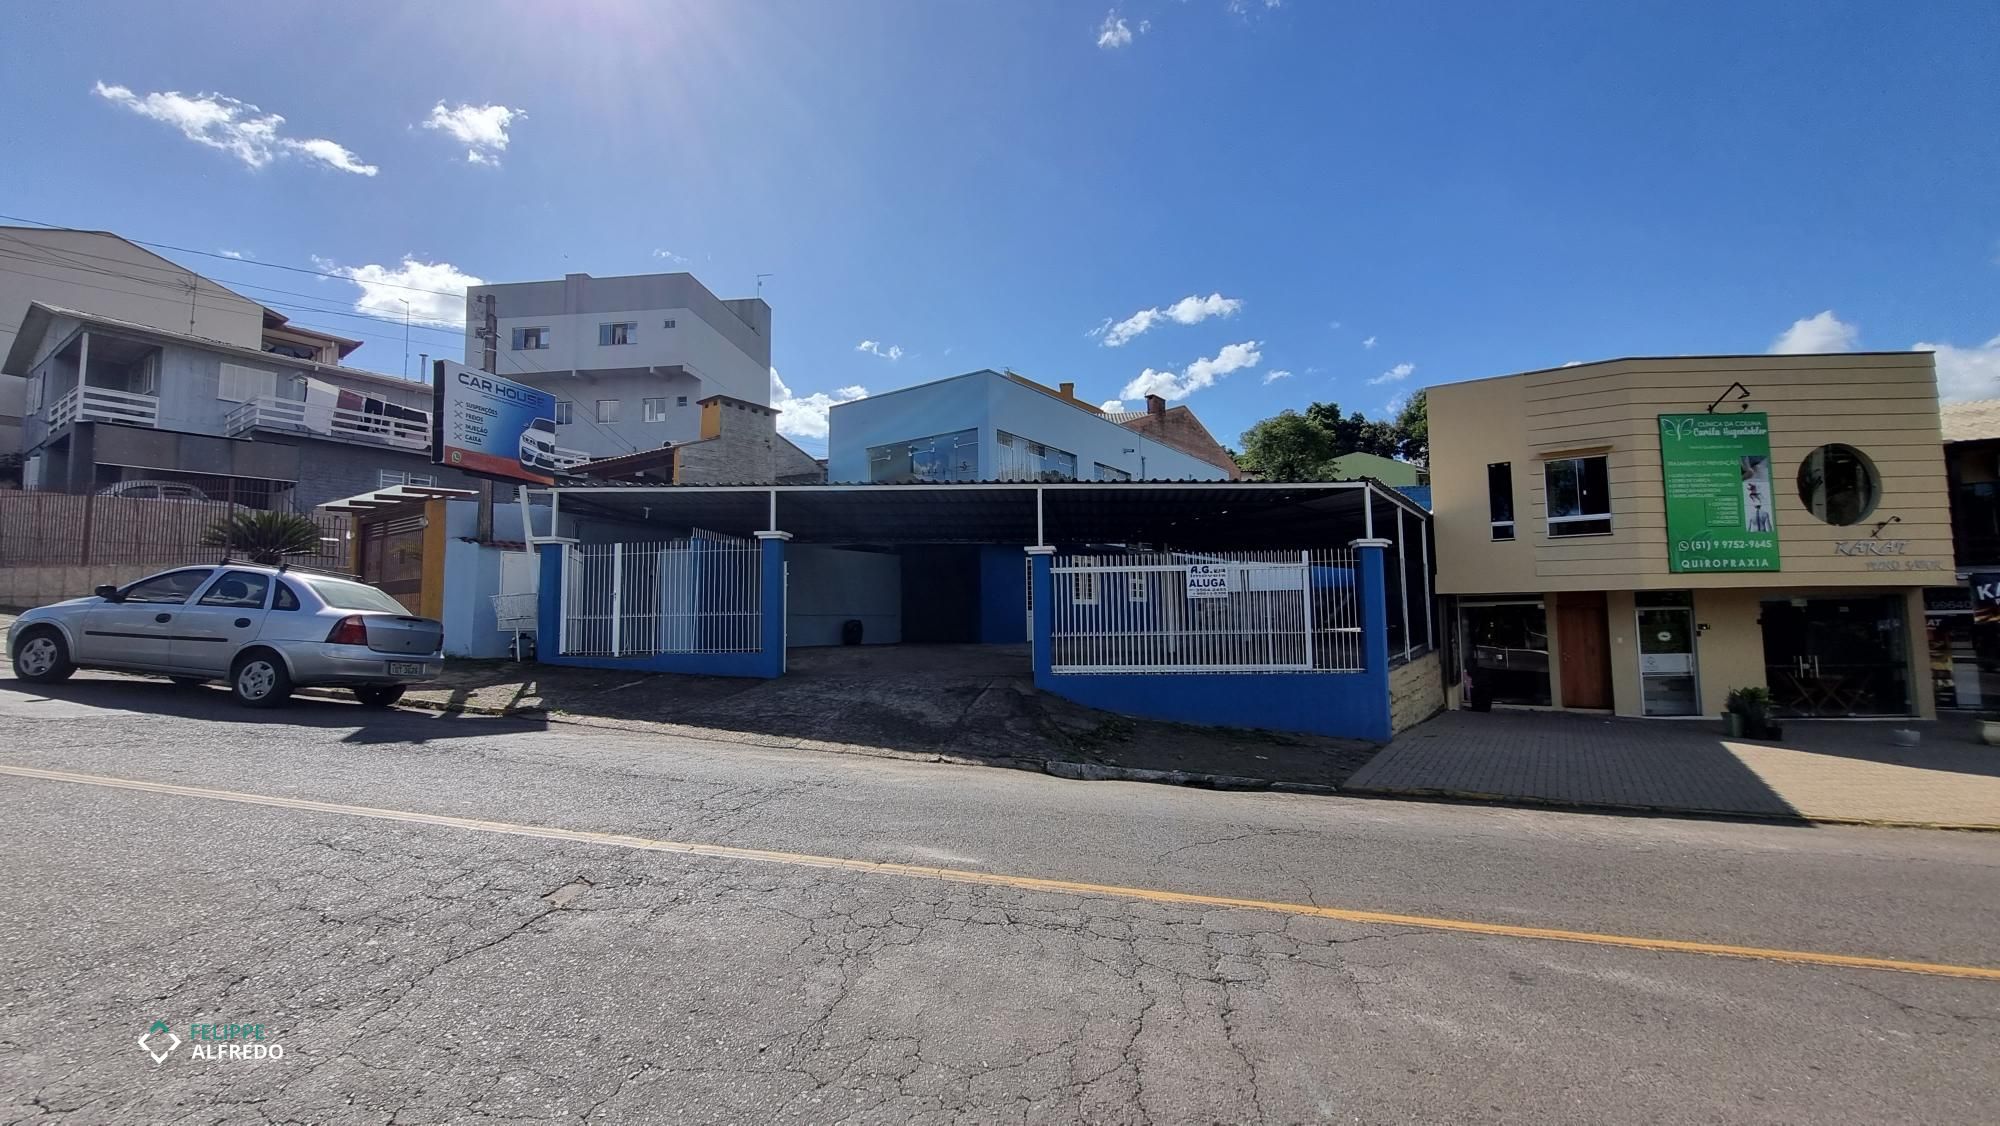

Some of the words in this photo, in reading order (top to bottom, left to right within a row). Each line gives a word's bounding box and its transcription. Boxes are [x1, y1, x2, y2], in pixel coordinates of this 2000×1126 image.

[458, 372, 492, 393] CAR
[495, 386, 545, 407] HOUSE
[465, 413, 484, 423] FREIOS
[465, 434, 482, 443] CAIXA
[1691, 540, 1712, 551] (51)
[1713, 540, 1719, 549] 9
[1721, 540, 1773, 549] 9752-9645
[1681, 559, 1769, 569] QUIROPRAXIA
[1189, 578, 1226, 587] ALUGA
